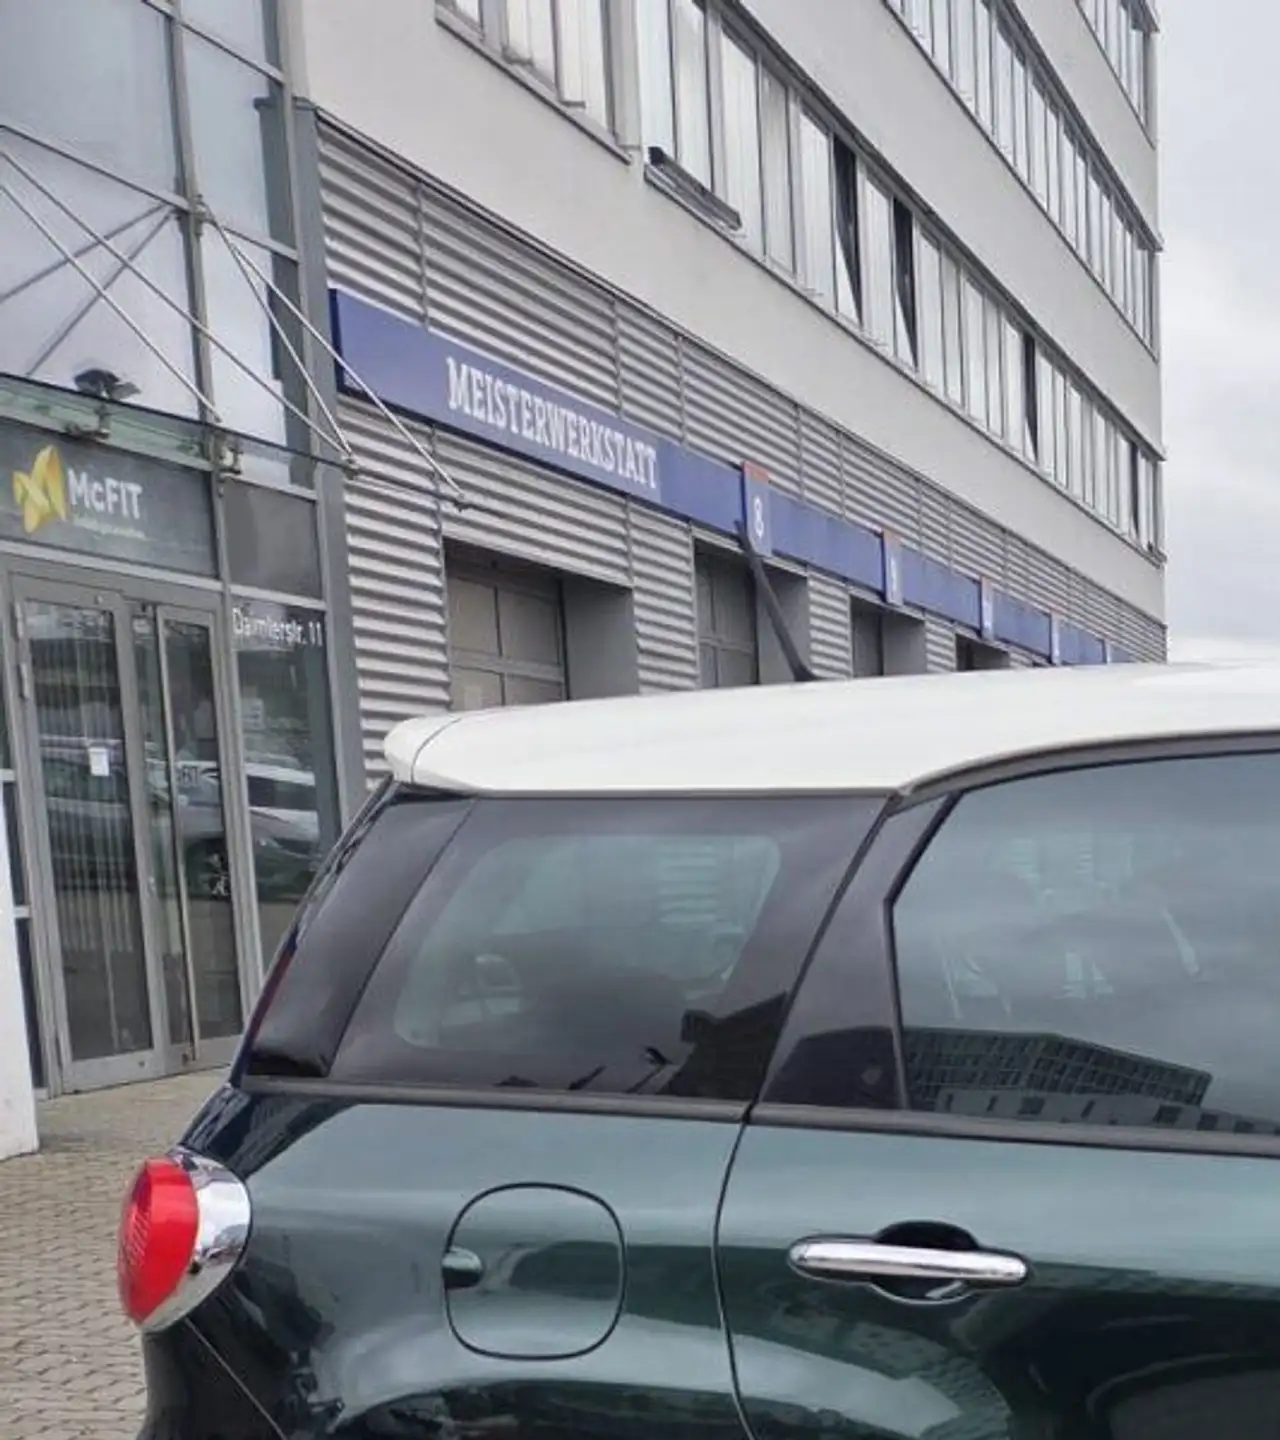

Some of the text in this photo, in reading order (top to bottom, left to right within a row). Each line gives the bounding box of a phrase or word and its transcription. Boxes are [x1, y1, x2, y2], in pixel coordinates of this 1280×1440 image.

[445, 356, 658, 489] MEISTERWERKSTATT
[67, 467, 143, 520] McFIT
[752, 496, 765, 539] 8
